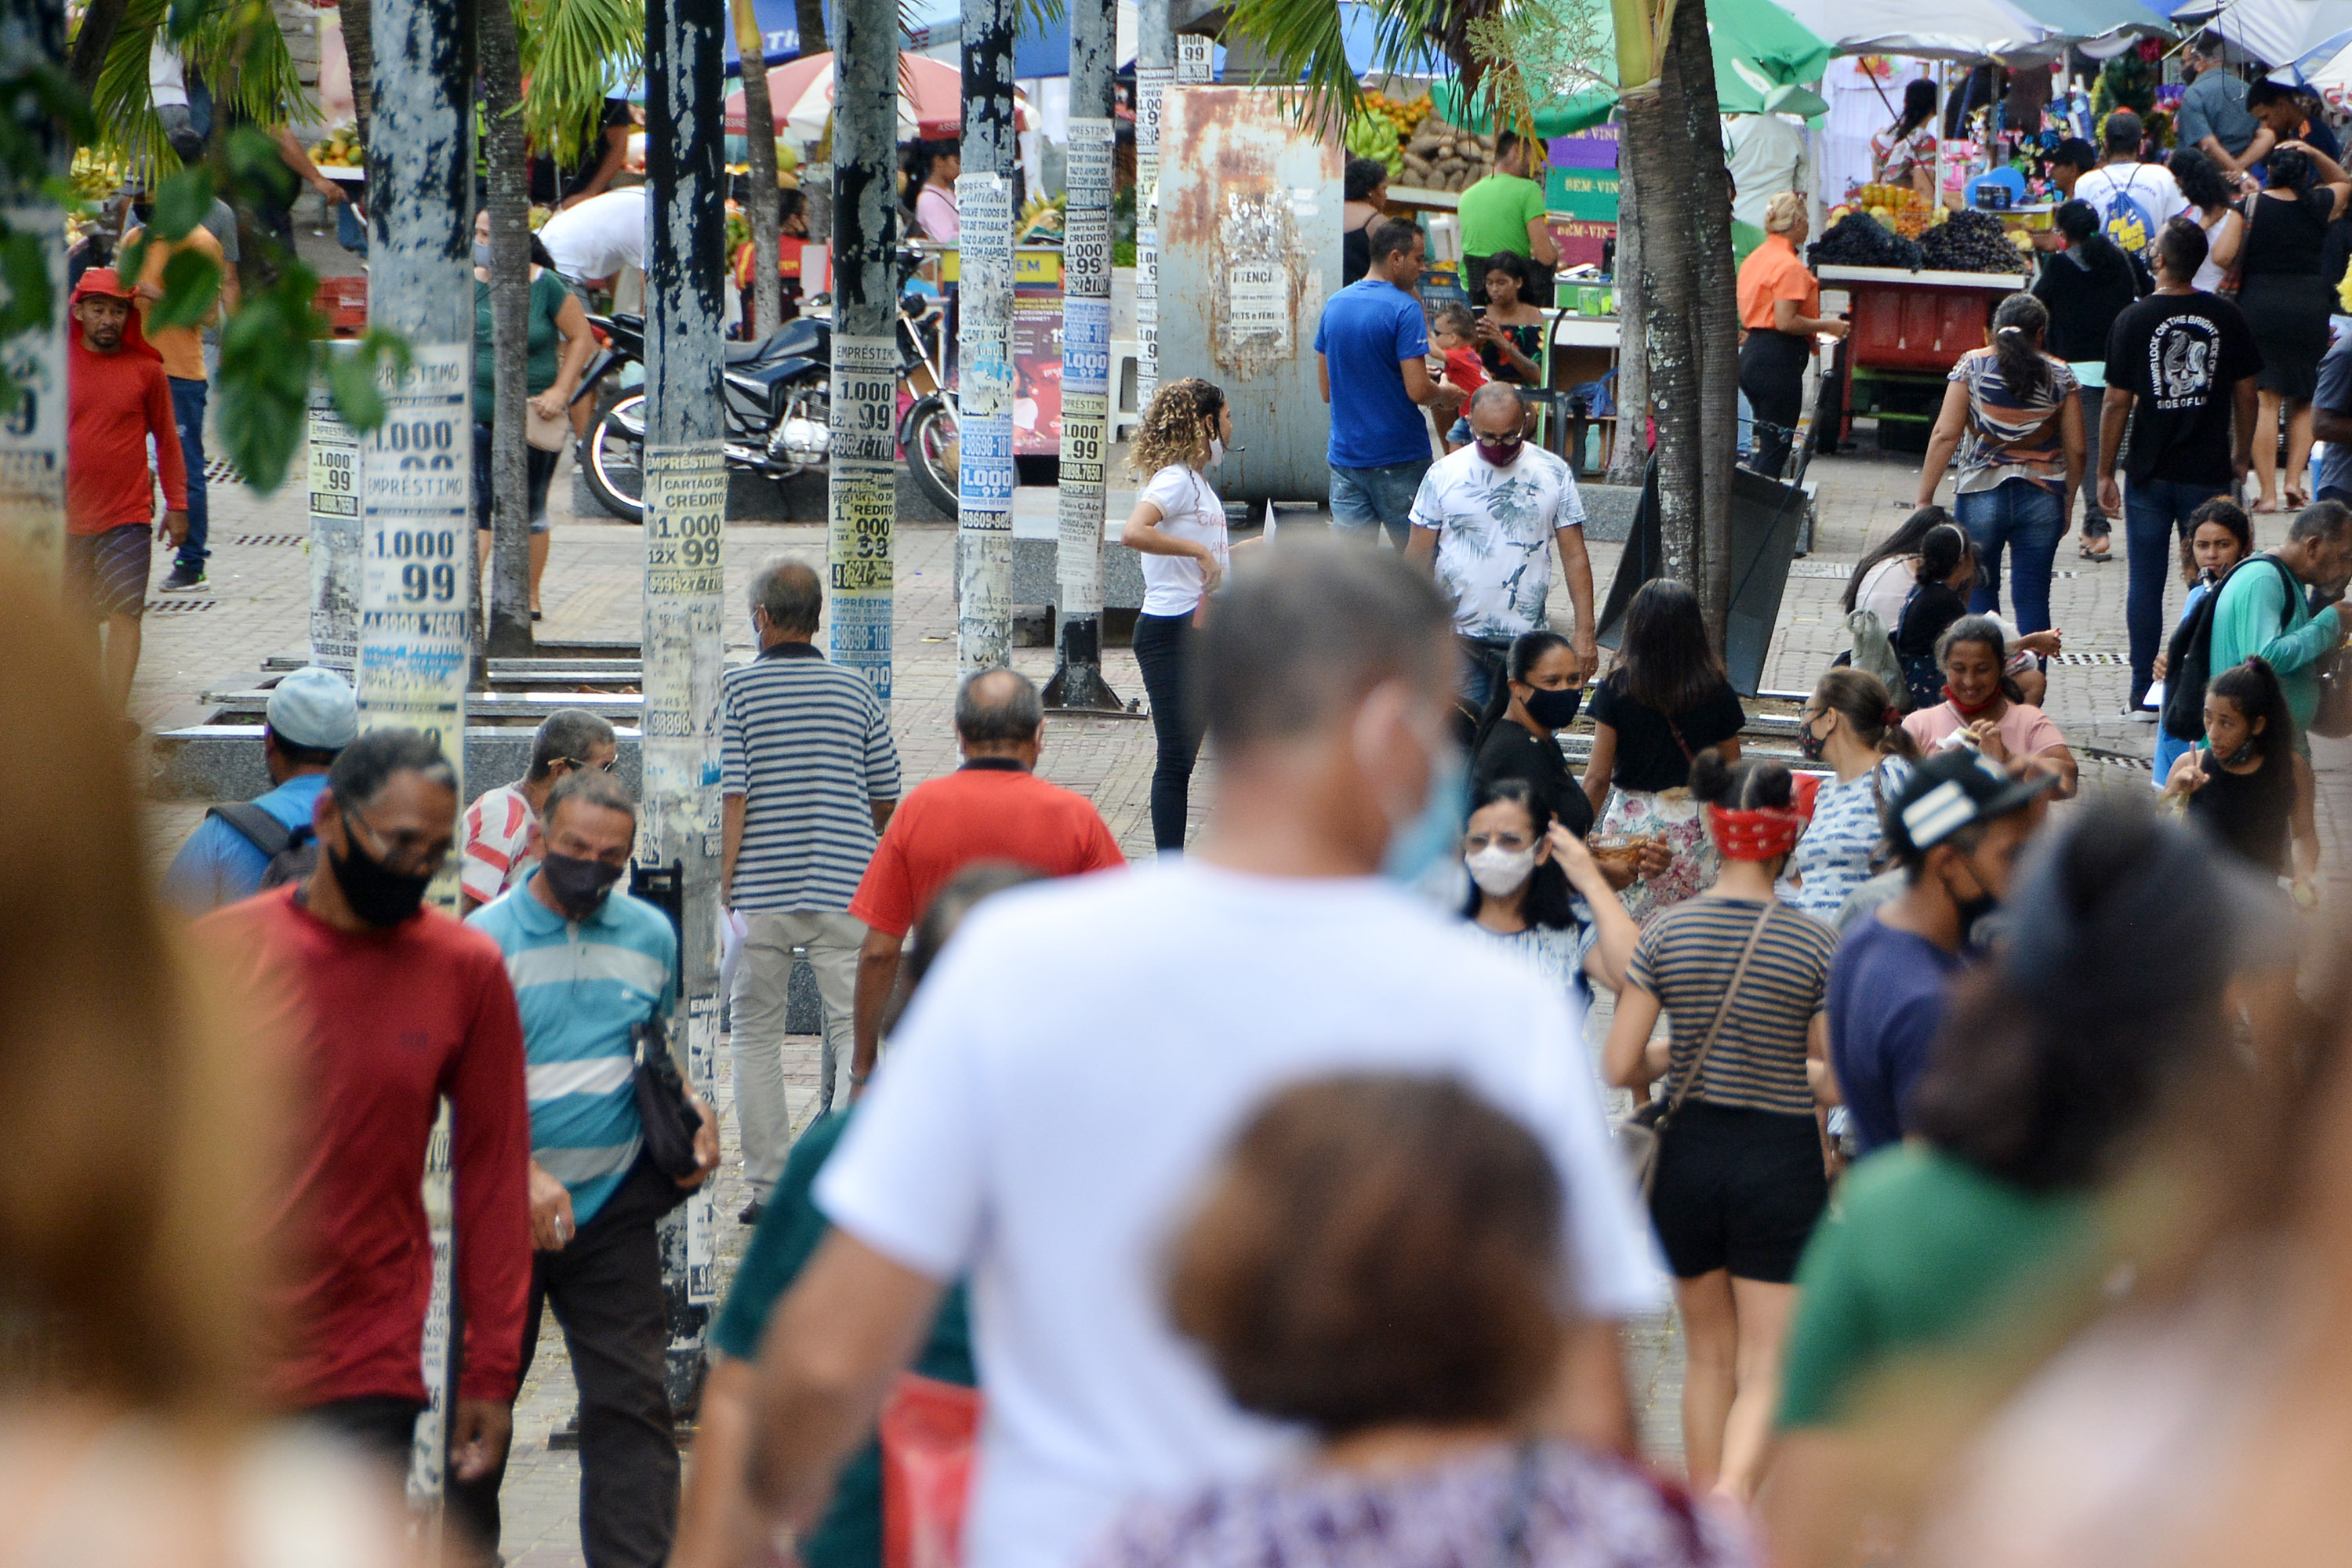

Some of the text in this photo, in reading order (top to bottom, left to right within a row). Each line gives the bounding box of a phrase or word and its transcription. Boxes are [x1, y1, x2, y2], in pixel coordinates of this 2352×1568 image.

[1185, 47, 1204, 60] 99
[1067, 243, 1102, 257] 1.000
[1076, 258, 1102, 274] 99
[2155, 321, 2170, 336] ON
[2166, 315, 2187, 326] THE
[2187, 315, 2220, 336] BRIGHT
[837, 344, 895, 360] EMPRÉSTIMO
[2150, 336, 2161, 362] LOOK
[1066, 352, 1108, 369] 1.000
[2151, 362, 2162, 396] ALWAYS
[841, 381, 891, 402] 1.000
[2157, 398, 2180, 408] SIDE
[2180, 398, 2194, 407] OF
[1064, 423, 1098, 439] 1.000
[1073, 440, 1098, 459] 99
[317, 452, 350, 469] 1.000
[329, 470, 351, 491] 99
[368, 474, 463, 496] EMPRÉSTIMO
[665, 477, 712, 491] CARTÃO
[964, 468, 1011, 487] 1.000
[666, 490, 724, 508] CRÉDITO
[982, 486, 1001, 498] 99
[851, 502, 893, 516] RÉDITO
[659, 514, 720, 539] 1.000
[375, 528, 454, 560] 1.000
[648, 538, 720, 567] 12X 99
[402, 563, 456, 603] 99
